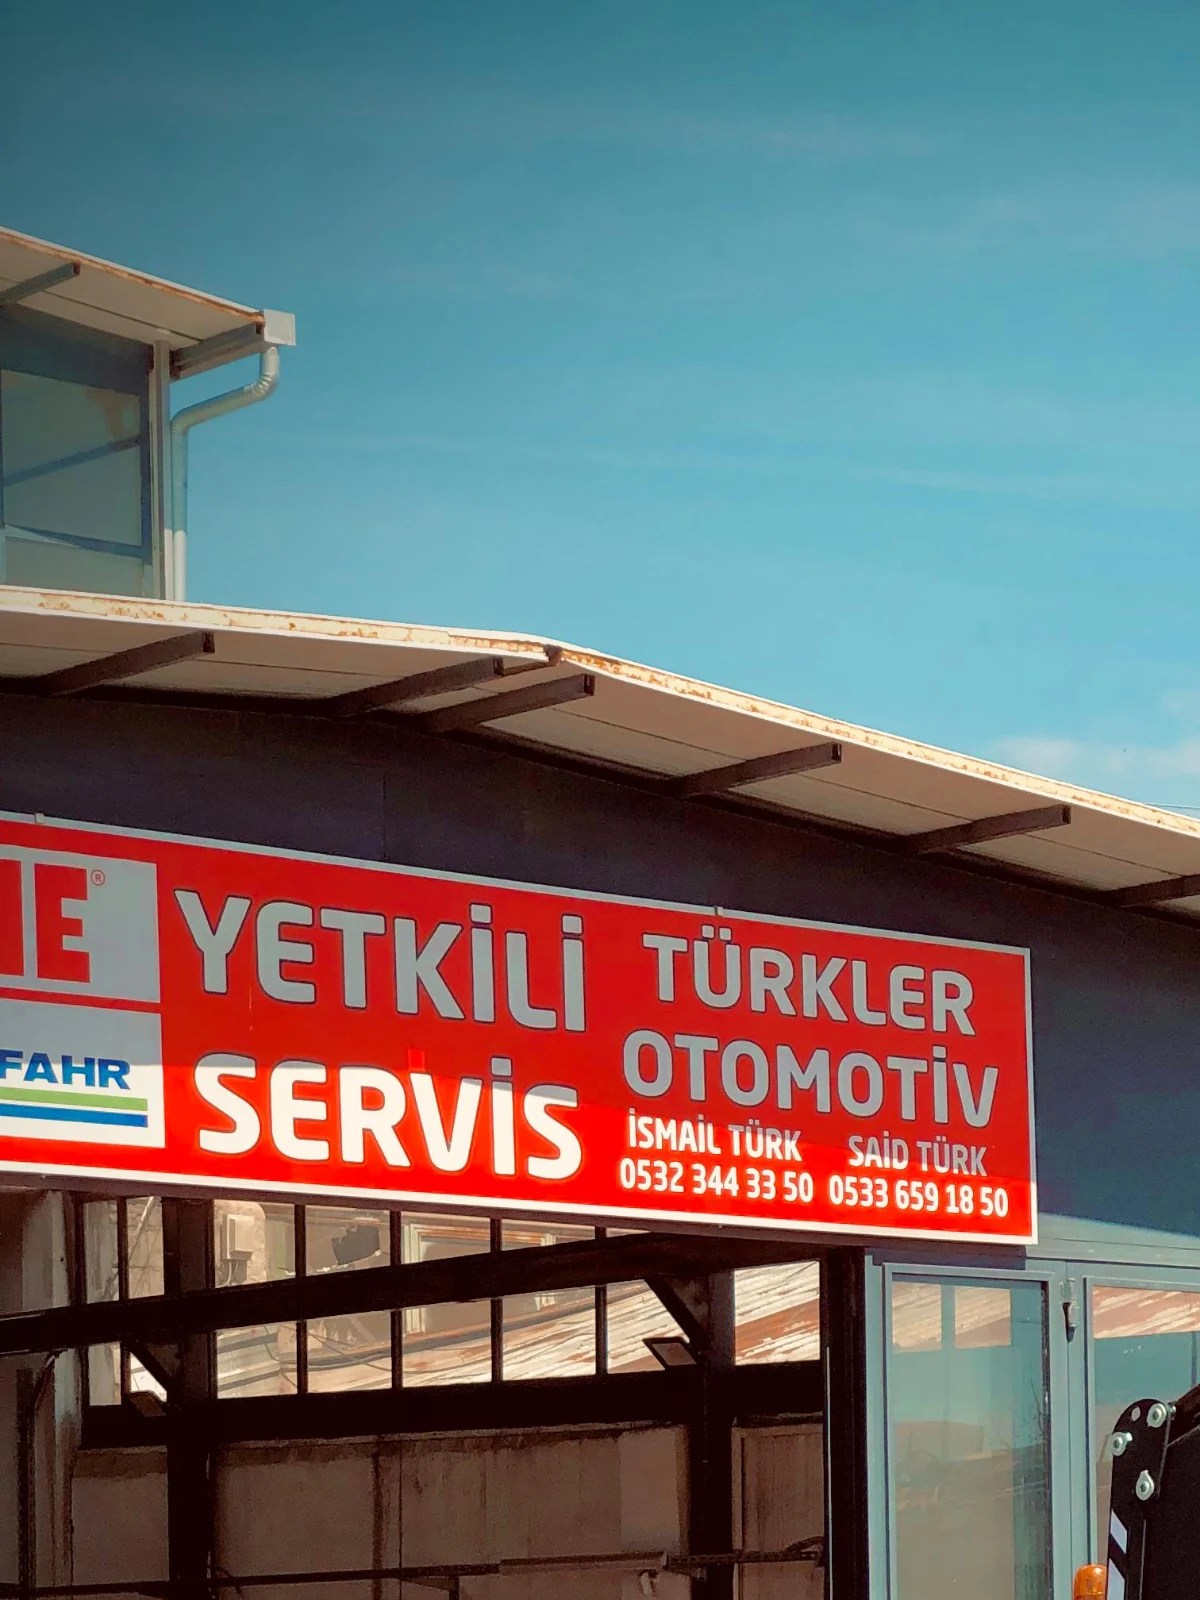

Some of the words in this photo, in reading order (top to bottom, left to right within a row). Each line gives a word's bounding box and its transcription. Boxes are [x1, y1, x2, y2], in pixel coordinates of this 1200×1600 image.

[174, 889, 586, 1032] YETKİLİ
[642, 924, 976, 1036] TÜRKLER
[194, 1052, 583, 1180] SERVİS
[622, 1029, 999, 1128] OTOMOTİV
[628, 1107, 722, 1155] İSMAİL
[728, 1118, 803, 1162] TÜRK
[848, 1130, 909, 1170] SAİD
[916, 1135, 988, 1177] TÜRK
[619, 1157, 685, 1193] 0532
[692, 1163, 740, 1197] 344
[745, 1167, 776, 1201] 33
[783, 1171, 814, 1203] 50
[829, 1174, 889, 1209] 0533
[894, 1179, 939, 1212] 659
[945, 1183, 974, 1215] 18
[980, 1186, 1009, 1218] 50
